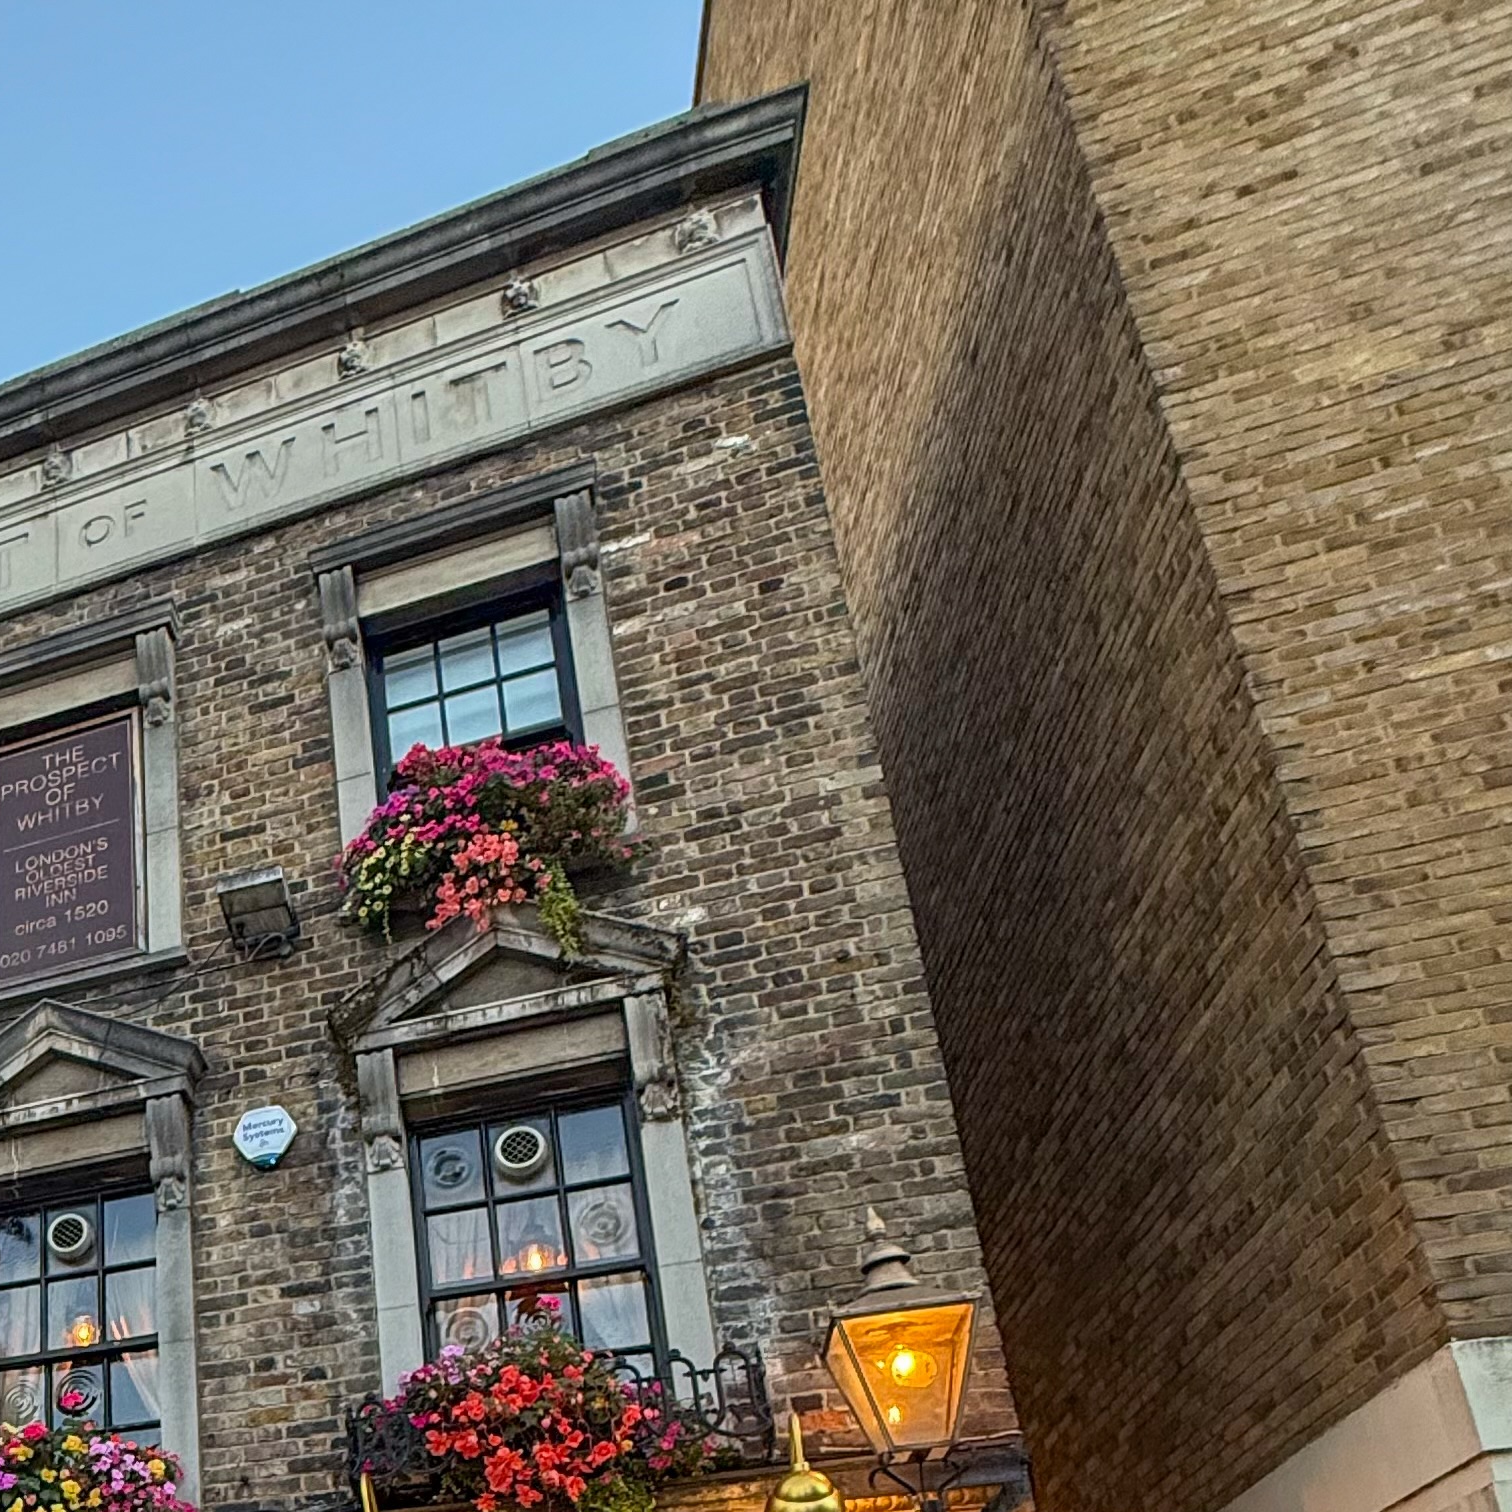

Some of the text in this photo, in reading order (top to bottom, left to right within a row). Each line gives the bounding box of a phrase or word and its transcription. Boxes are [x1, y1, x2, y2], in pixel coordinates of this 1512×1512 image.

[79, 499, 147, 549] OF
[210, 298, 680, 511] WHITBY
[41, 745, 85, 771] THE
[0, 752, 122, 802] PROSPECT
[45, 783, 76, 806] OF
[16, 793, 105, 832] WHITBY
[15, 837, 108, 873] LONDON'S
[25, 854, 96, 884] OLDEST
[14, 865, 108, 901] RIVERSIDE
[46, 888, 77, 908] INN
[15, 900, 109, 936] circa 1520
[0, 924, 127, 968] 020 7481 1095
